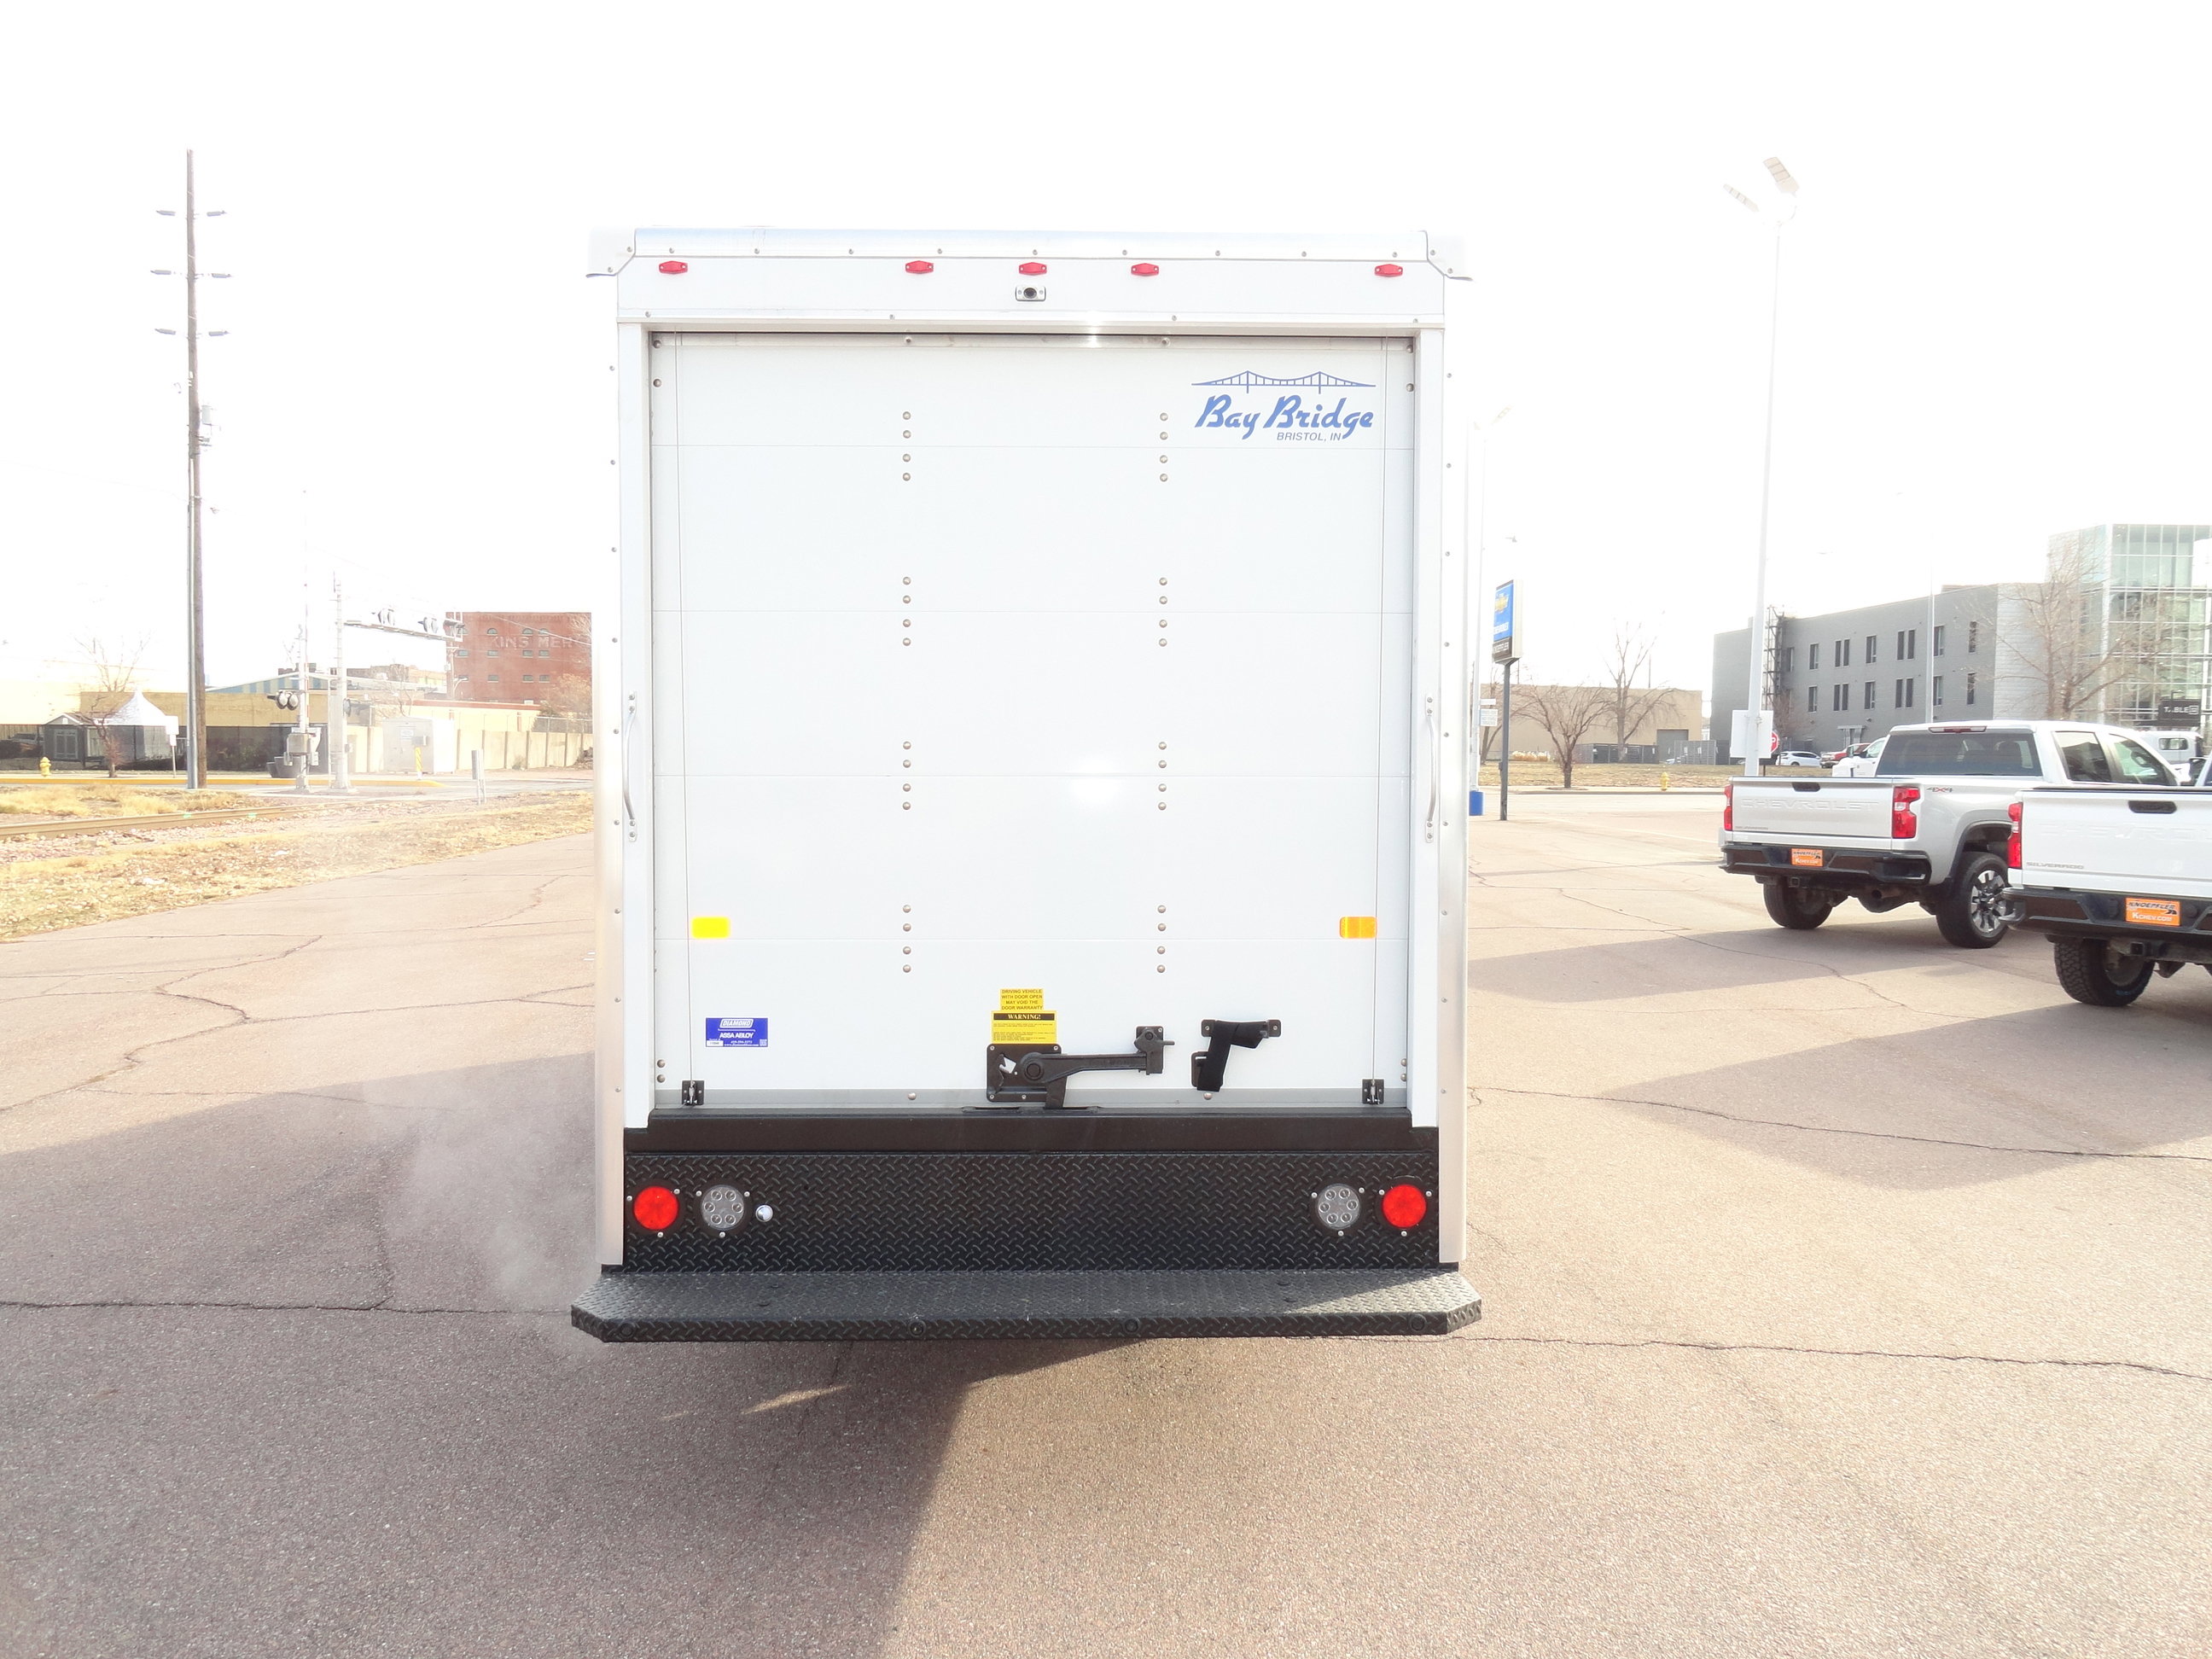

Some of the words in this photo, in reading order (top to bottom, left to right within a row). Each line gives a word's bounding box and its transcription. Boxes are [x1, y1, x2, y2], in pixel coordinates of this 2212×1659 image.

[1195, 393, 1260, 440] Bay
[1262, 394, 1374, 440] Bridge
[1277, 432, 1326, 442] BRISTOL,
[1330, 432, 1342, 441] IN
[1740, 798, 1878, 812] CHEVROLET
[2026, 861, 2085, 870] SILVERADO
